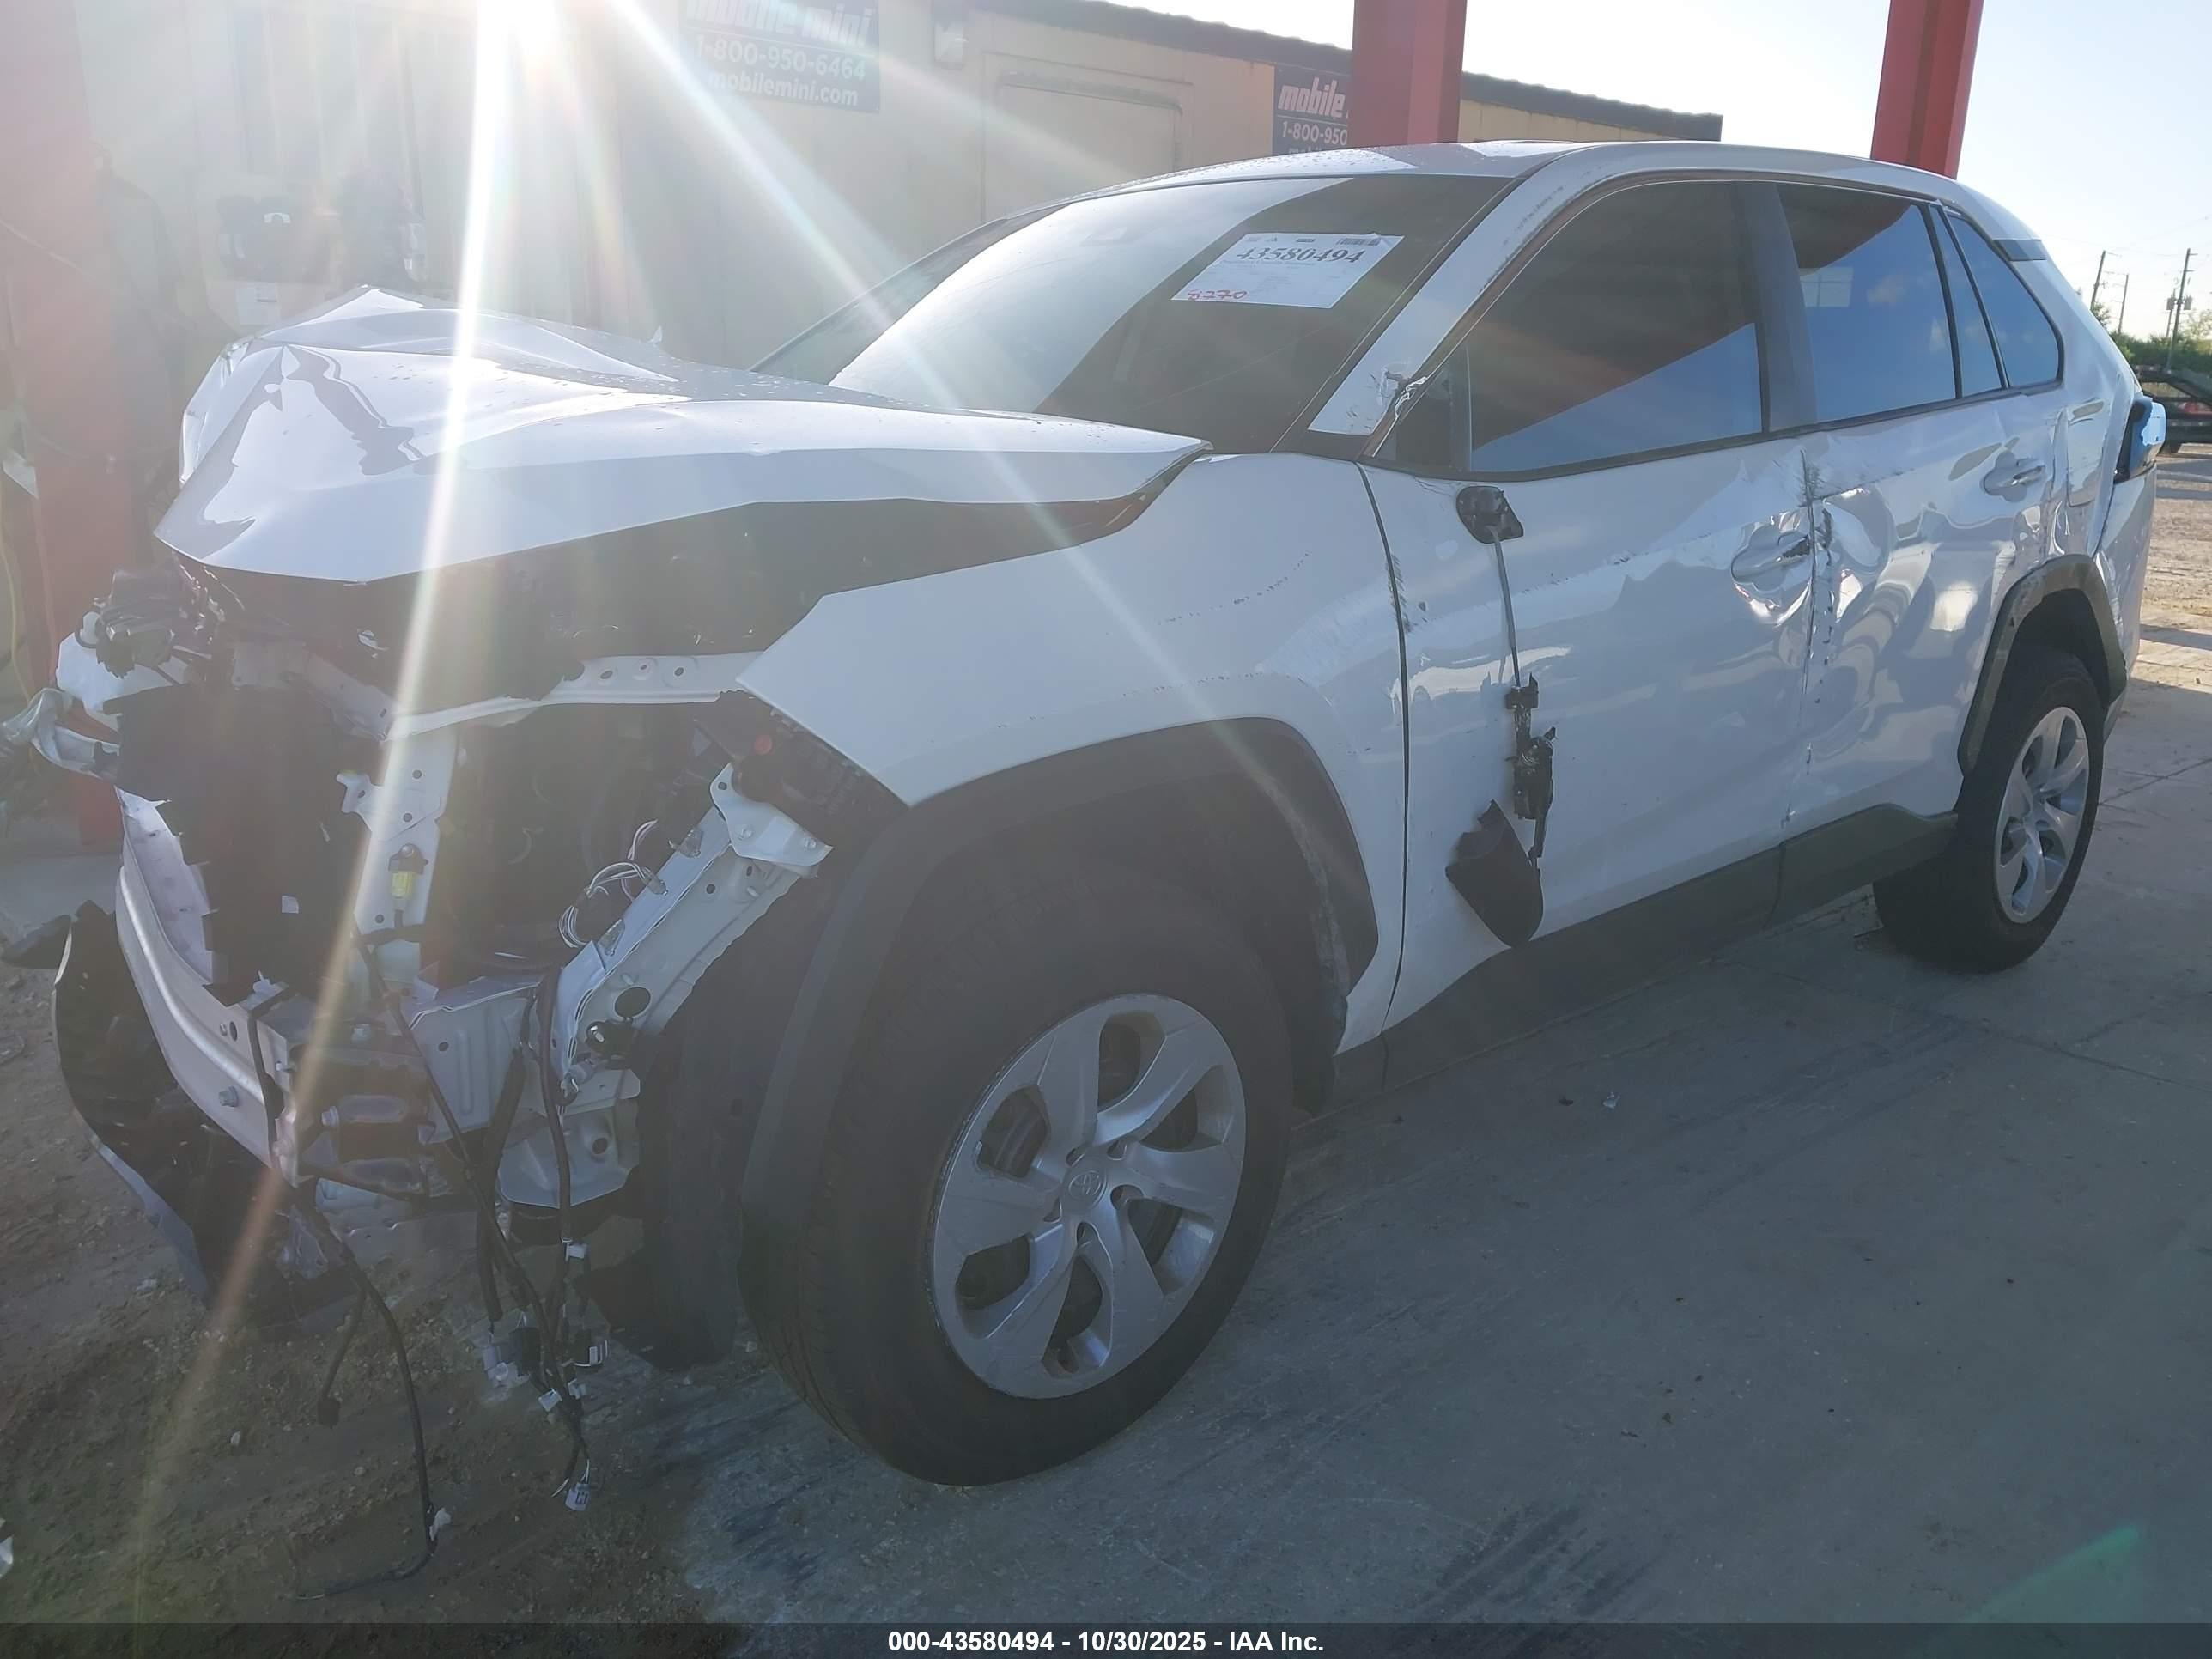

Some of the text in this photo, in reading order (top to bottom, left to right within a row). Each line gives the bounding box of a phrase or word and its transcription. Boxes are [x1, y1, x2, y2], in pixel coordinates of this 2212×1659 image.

[800, 3, 876, 49] mini
[696, 33, 866, 81] 1-800-950-6464
[708, 70, 860, 106] mobilemini.com
[1277, 76, 1346, 118] mobile
[1237, 246, 1366, 264] 43580494
